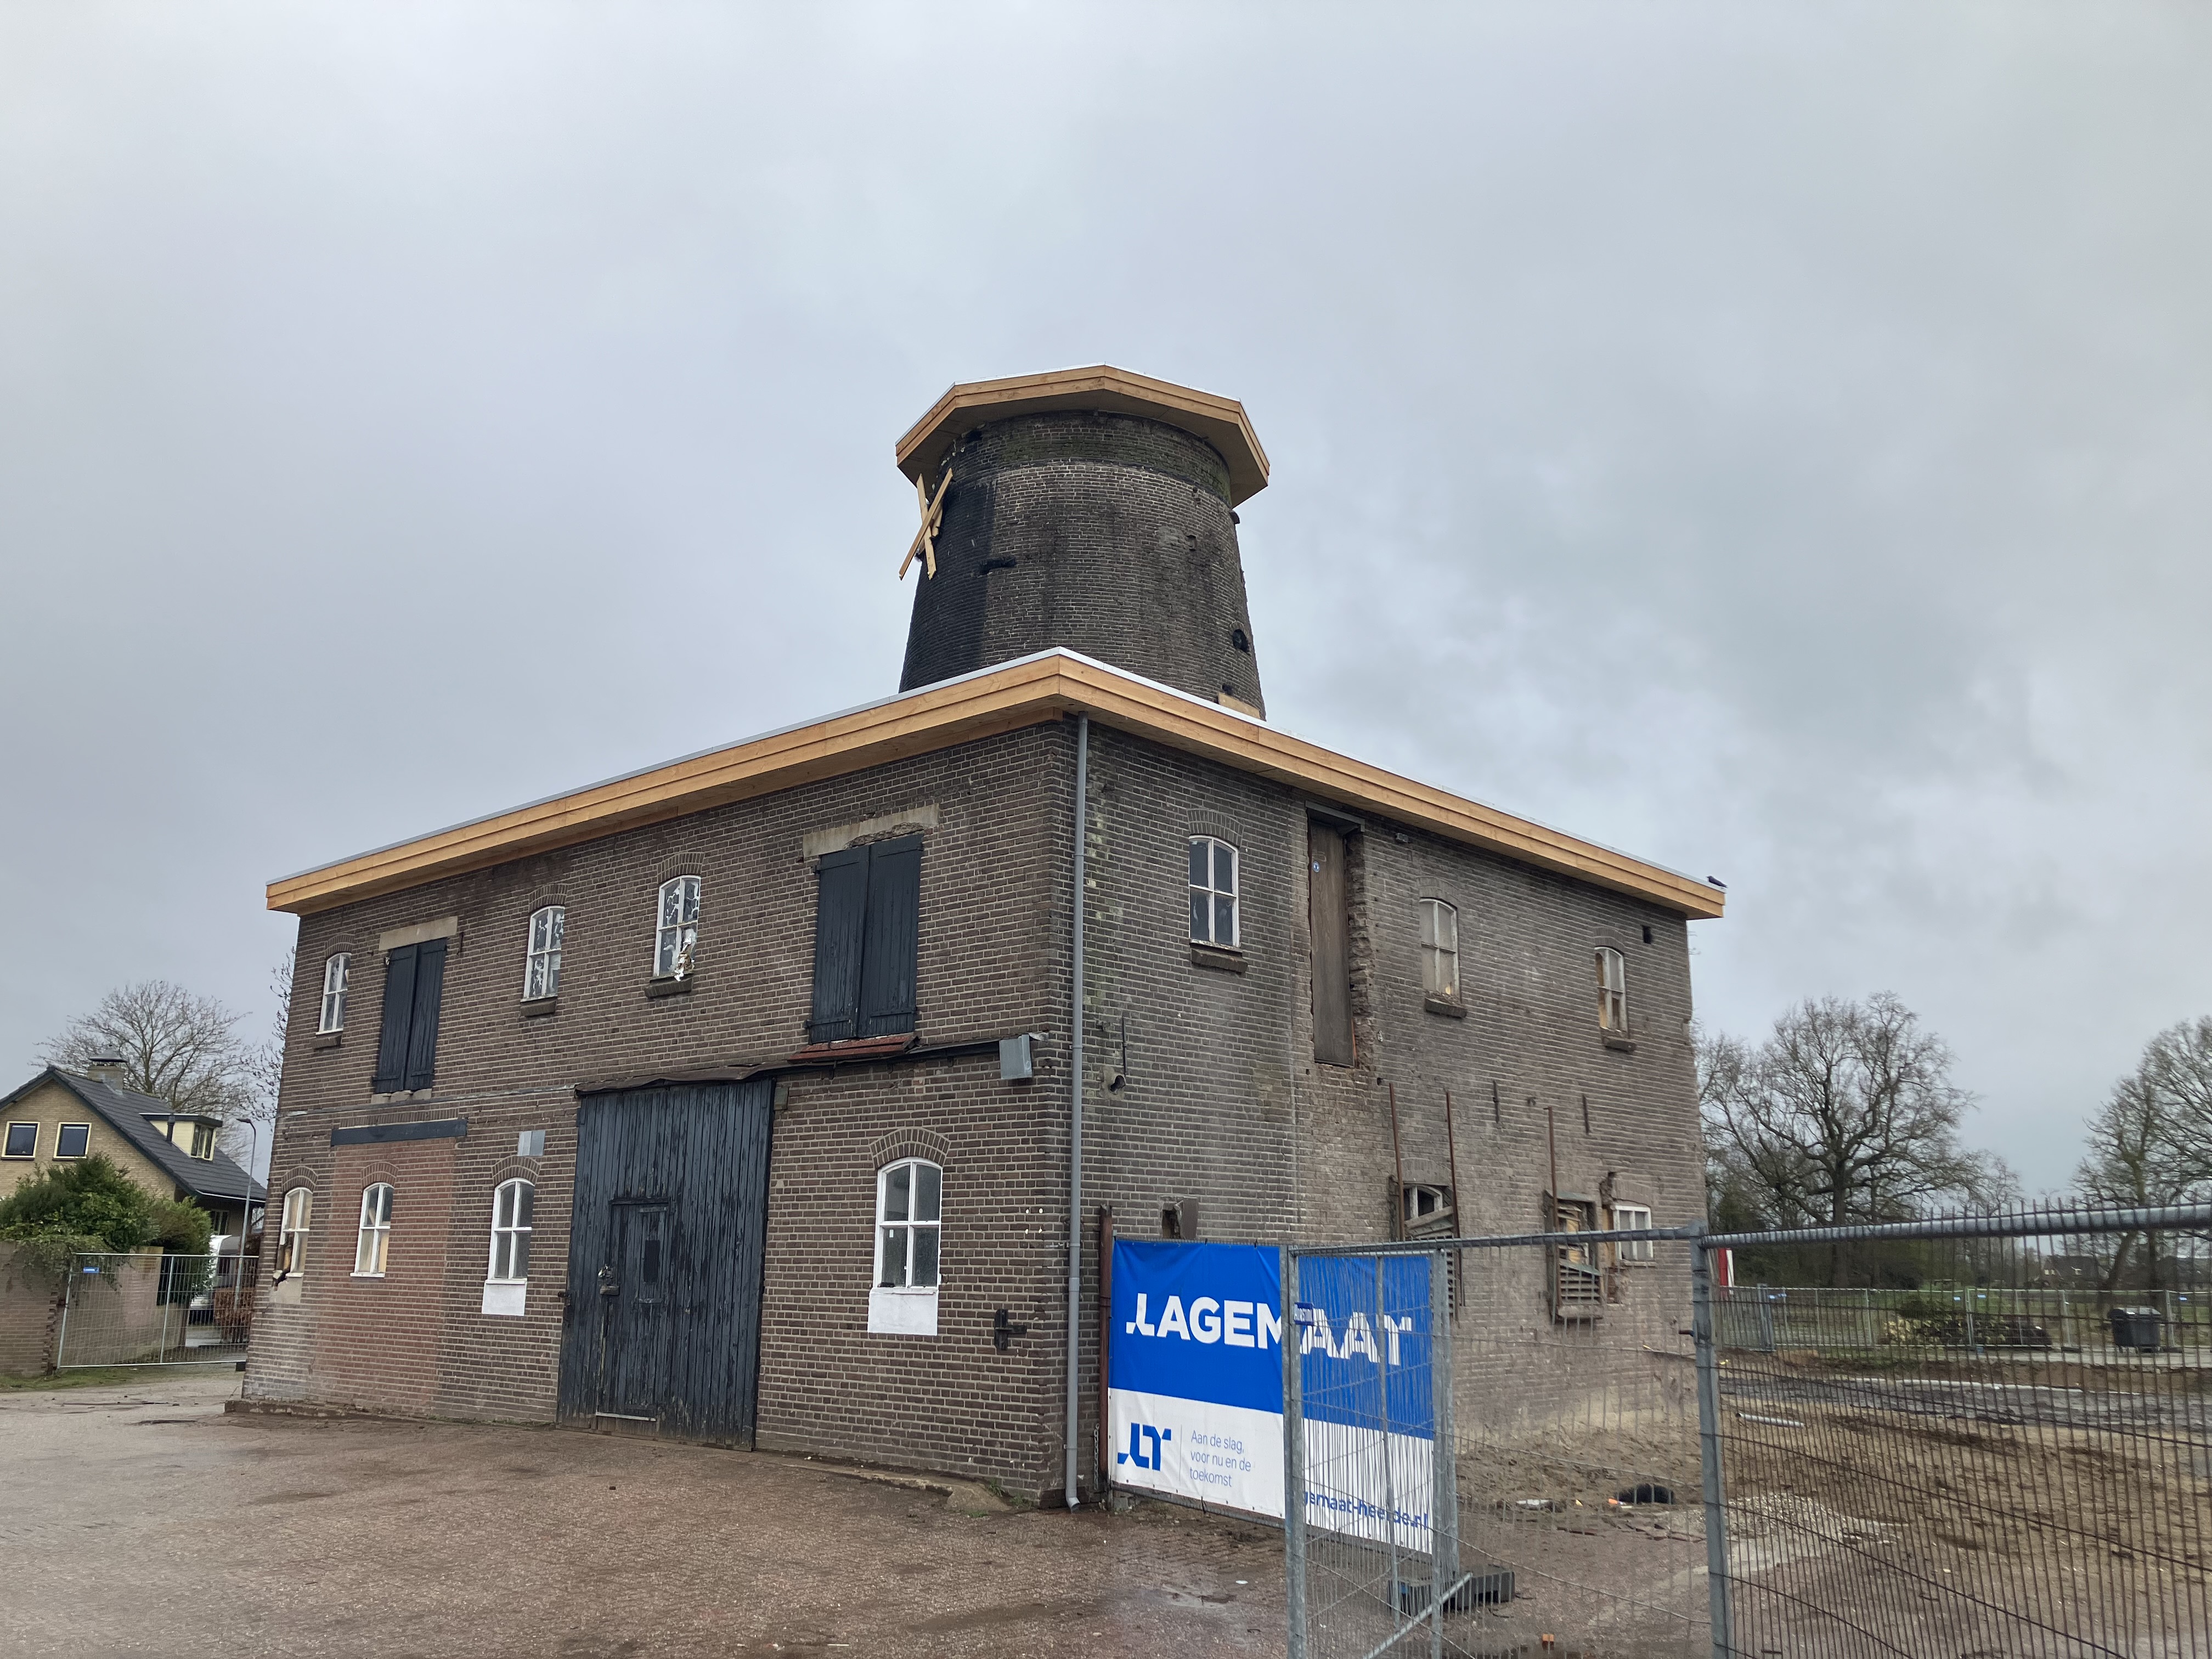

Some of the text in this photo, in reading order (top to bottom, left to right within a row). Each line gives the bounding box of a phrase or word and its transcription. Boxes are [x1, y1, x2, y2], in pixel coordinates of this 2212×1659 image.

[1191, 1430, 1244, 1454] Aan de slag,
[1190, 1451, 1251, 1472] voor nu en de
[1189, 1467, 1232, 1487] toekomst
